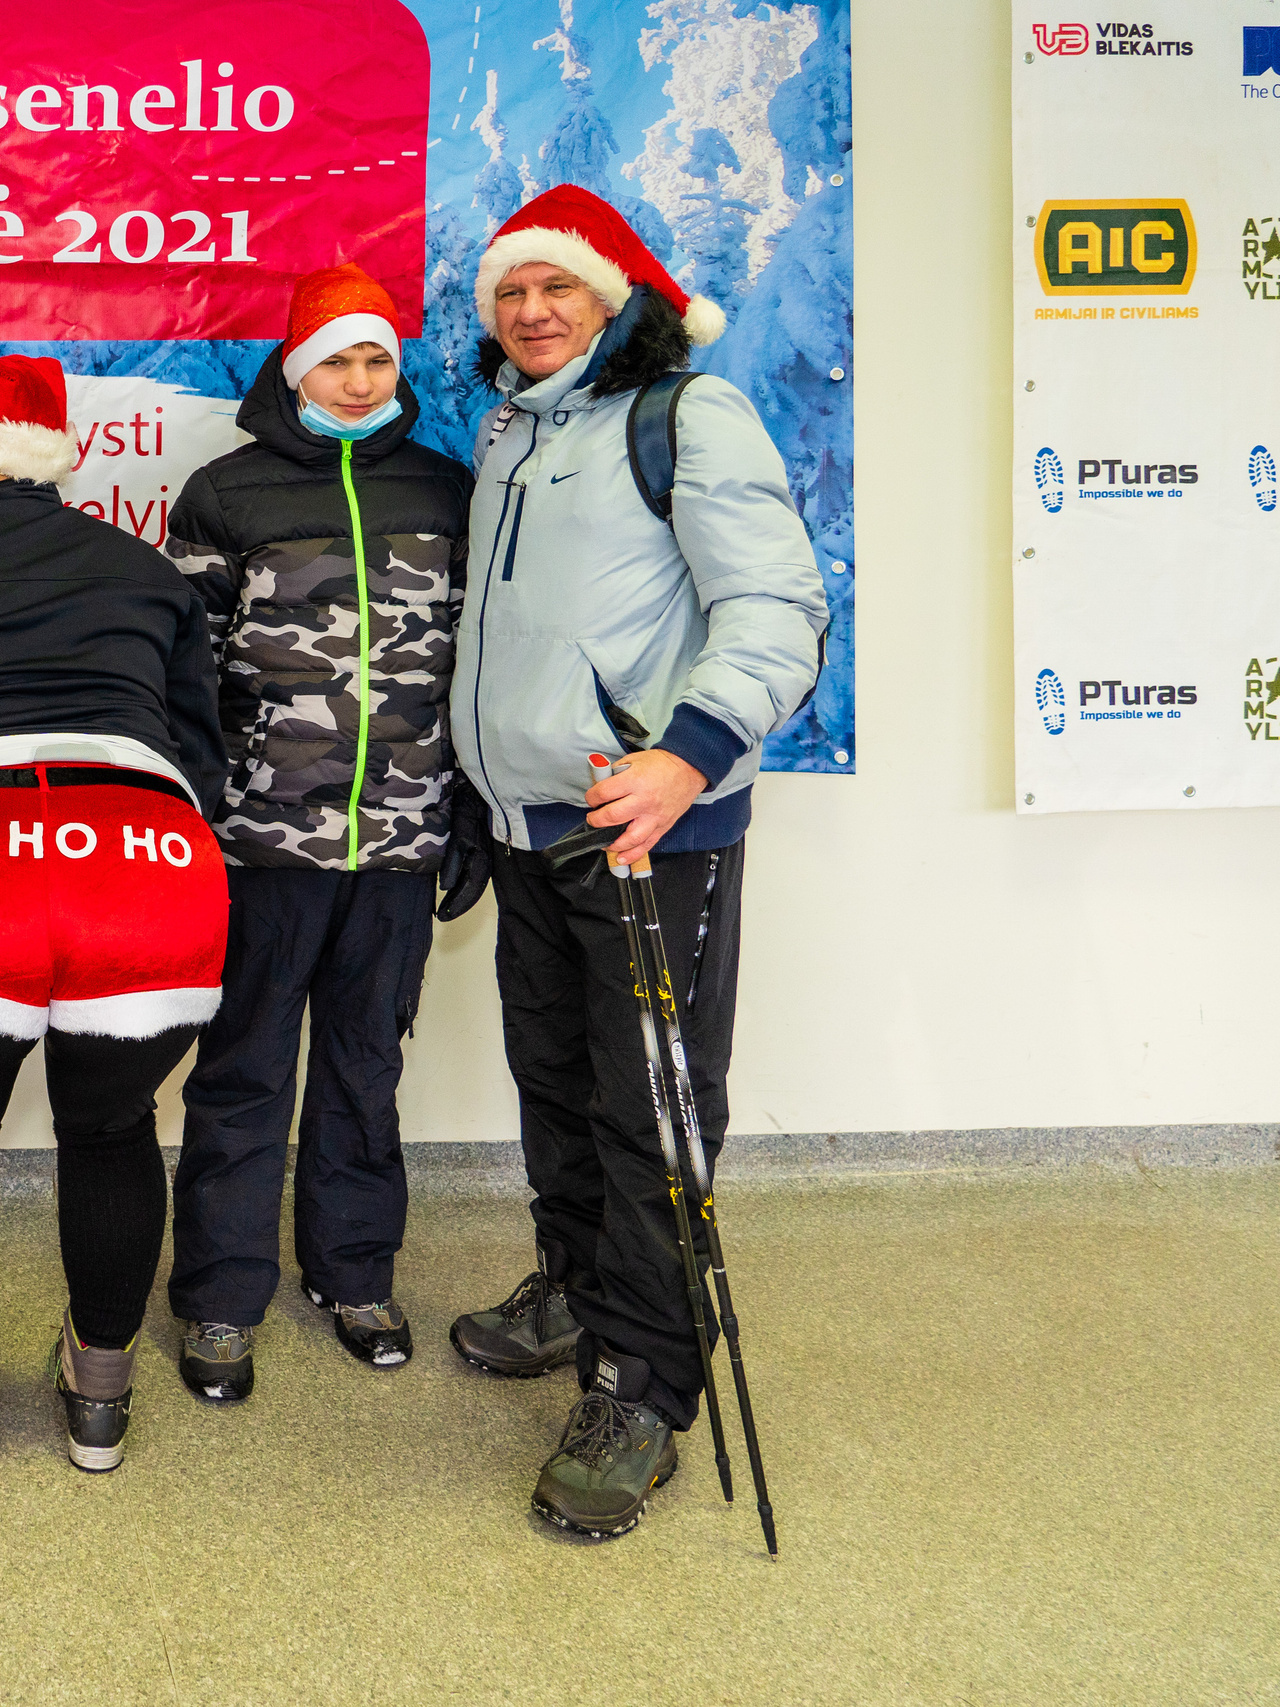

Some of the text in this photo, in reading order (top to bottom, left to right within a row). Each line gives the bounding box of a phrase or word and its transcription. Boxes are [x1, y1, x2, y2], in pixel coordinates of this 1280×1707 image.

[1096, 23, 1154, 38] VIDAS
[1096, 41, 1193, 56] BLEKAITIS
[1241, 84, 1268, 99] The
[53, 209, 258, 264] 2021
[1058, 220, 1175, 274] AIC
[1035, 307, 1199, 320] ARMIJAI IR CIVILIAMS
[1078, 459, 1198, 485] PTuras
[1078, 489, 1183, 500] Impossible we do
[1079, 680, 1198, 706] PTuras
[1079, 710, 1181, 721] Impossible we do
[8, 821, 98, 859] HO
[123, 825, 193, 868] HO
[596, 1376, 614, 1391] PLUS
